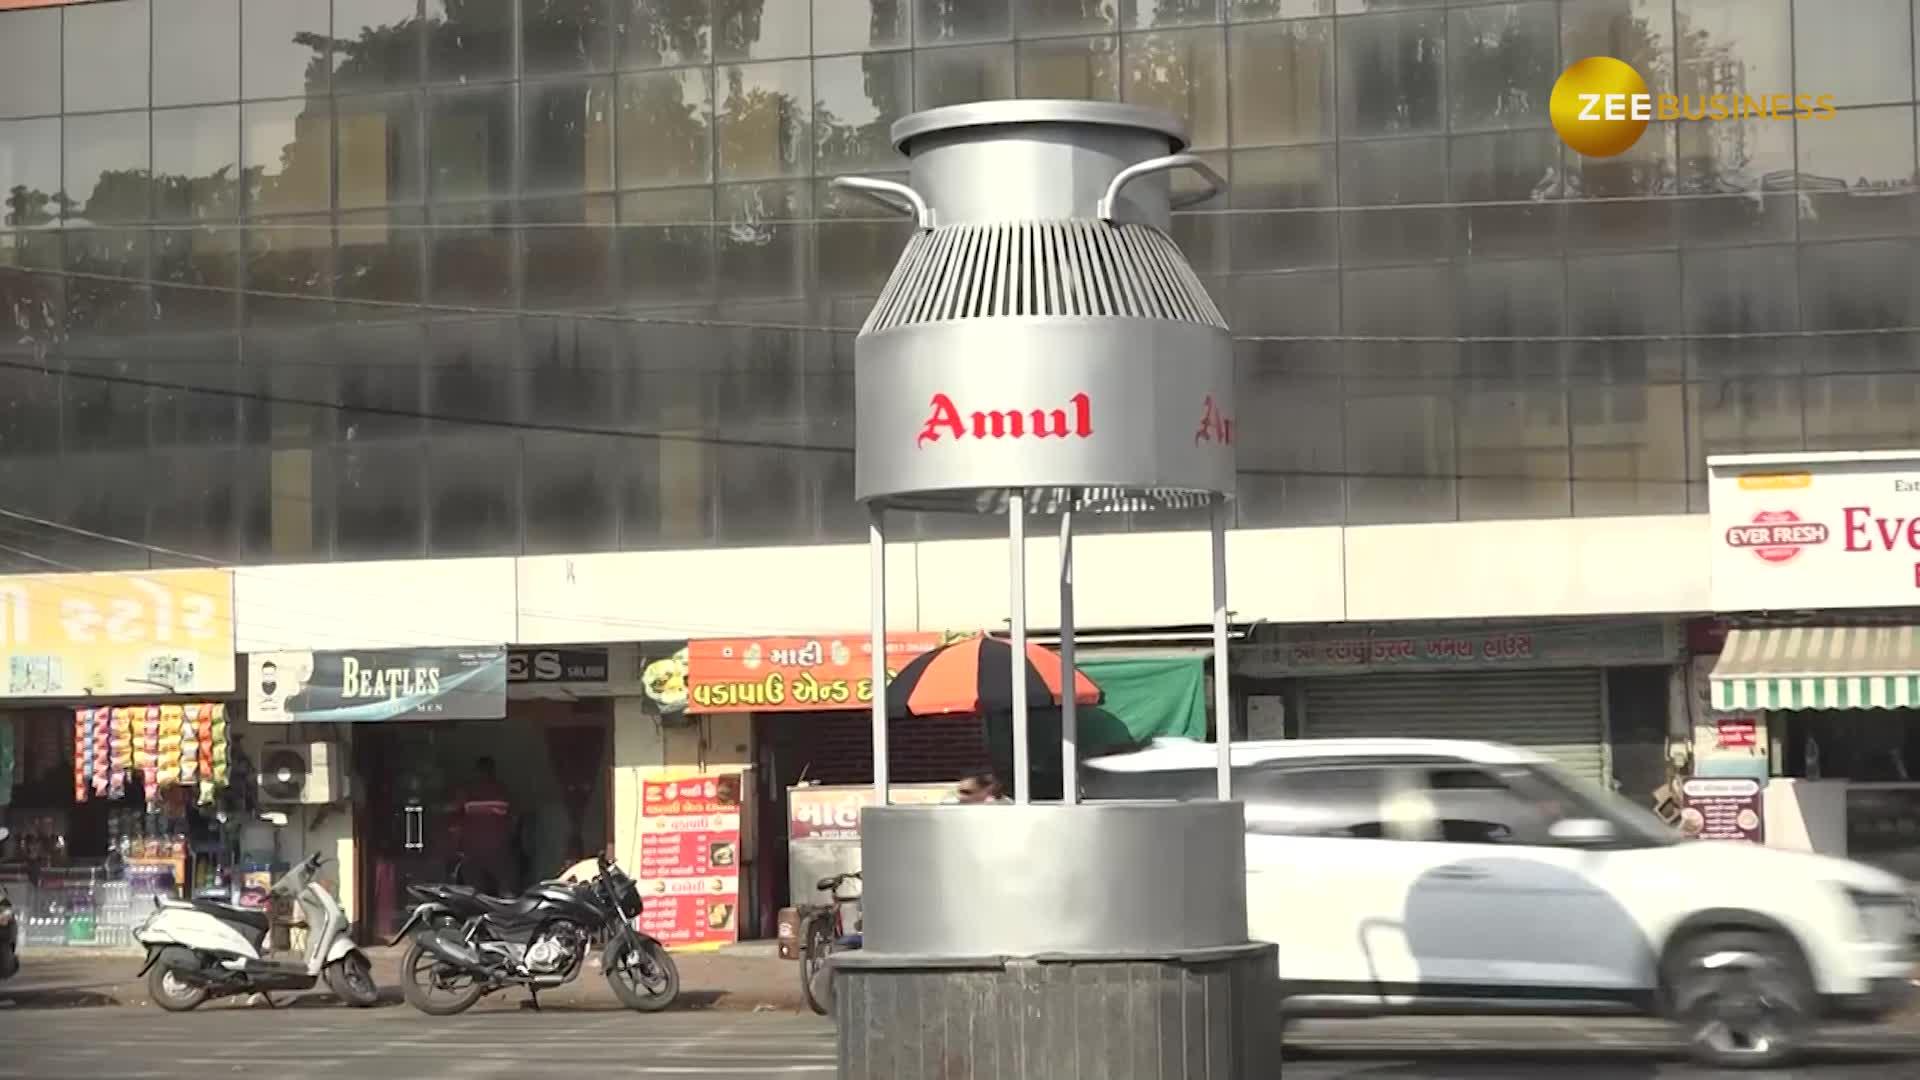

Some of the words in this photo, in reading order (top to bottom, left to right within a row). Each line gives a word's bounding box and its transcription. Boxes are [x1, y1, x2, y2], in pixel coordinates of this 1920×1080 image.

[916, 391, 1095, 451] Amul
[1729, 527, 1772, 545] EVER
[1774, 525, 1825, 544] FRESH
[769, 640, 823, 666] માહી
[341, 657, 440, 703] BEATLES
[693, 672, 785, 706] વડાપાઉ
[792, 672, 850, 703] એન્ડ
[416, 704, 443, 713] MEN
